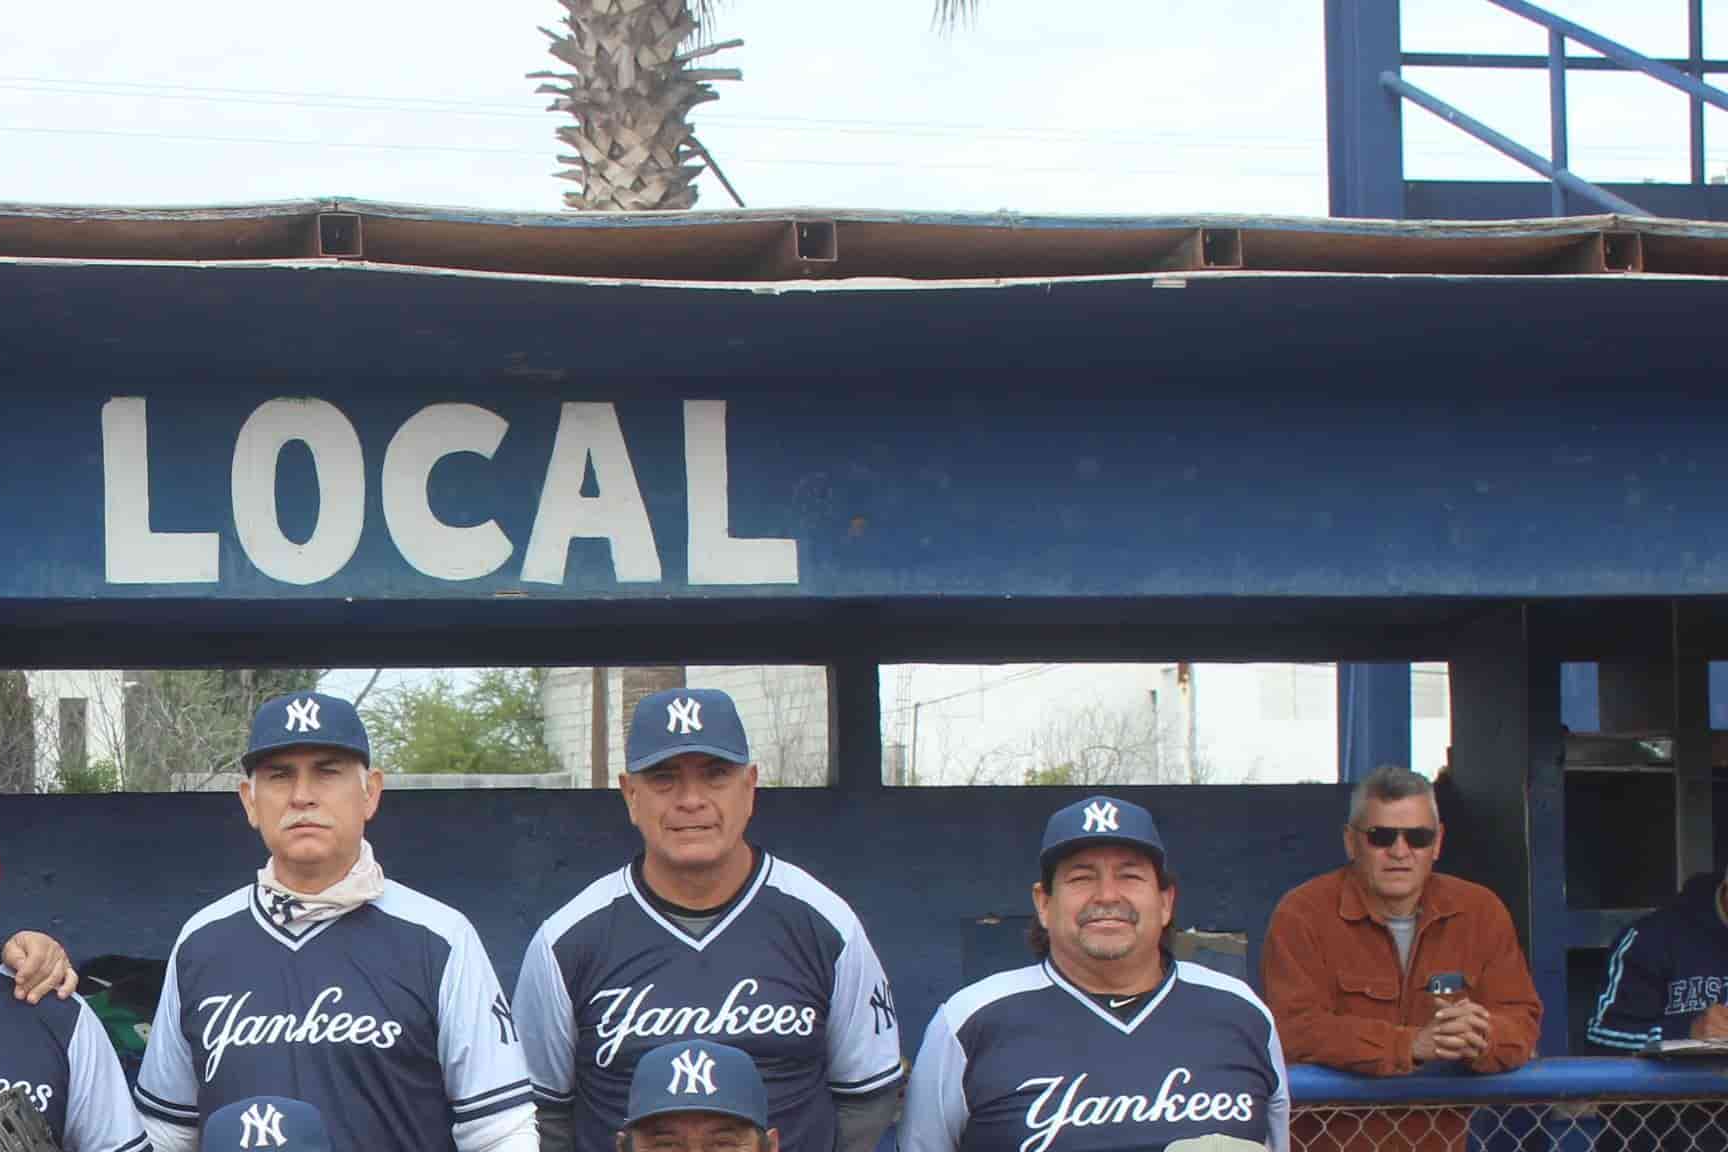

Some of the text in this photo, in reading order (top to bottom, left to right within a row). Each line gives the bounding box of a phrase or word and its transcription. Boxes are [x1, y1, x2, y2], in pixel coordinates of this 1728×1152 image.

[101, 395, 800, 586] LOCAL
[285, 697, 321, 732] NY
[667, 697, 704, 734] NY
[1082, 801, 1120, 833] NY
[197, 986, 403, 1083] Yankees
[588, 978, 817, 1069] Yankees
[667, 1048, 718, 1095] NY
[239, 1103, 288, 1149] NY
